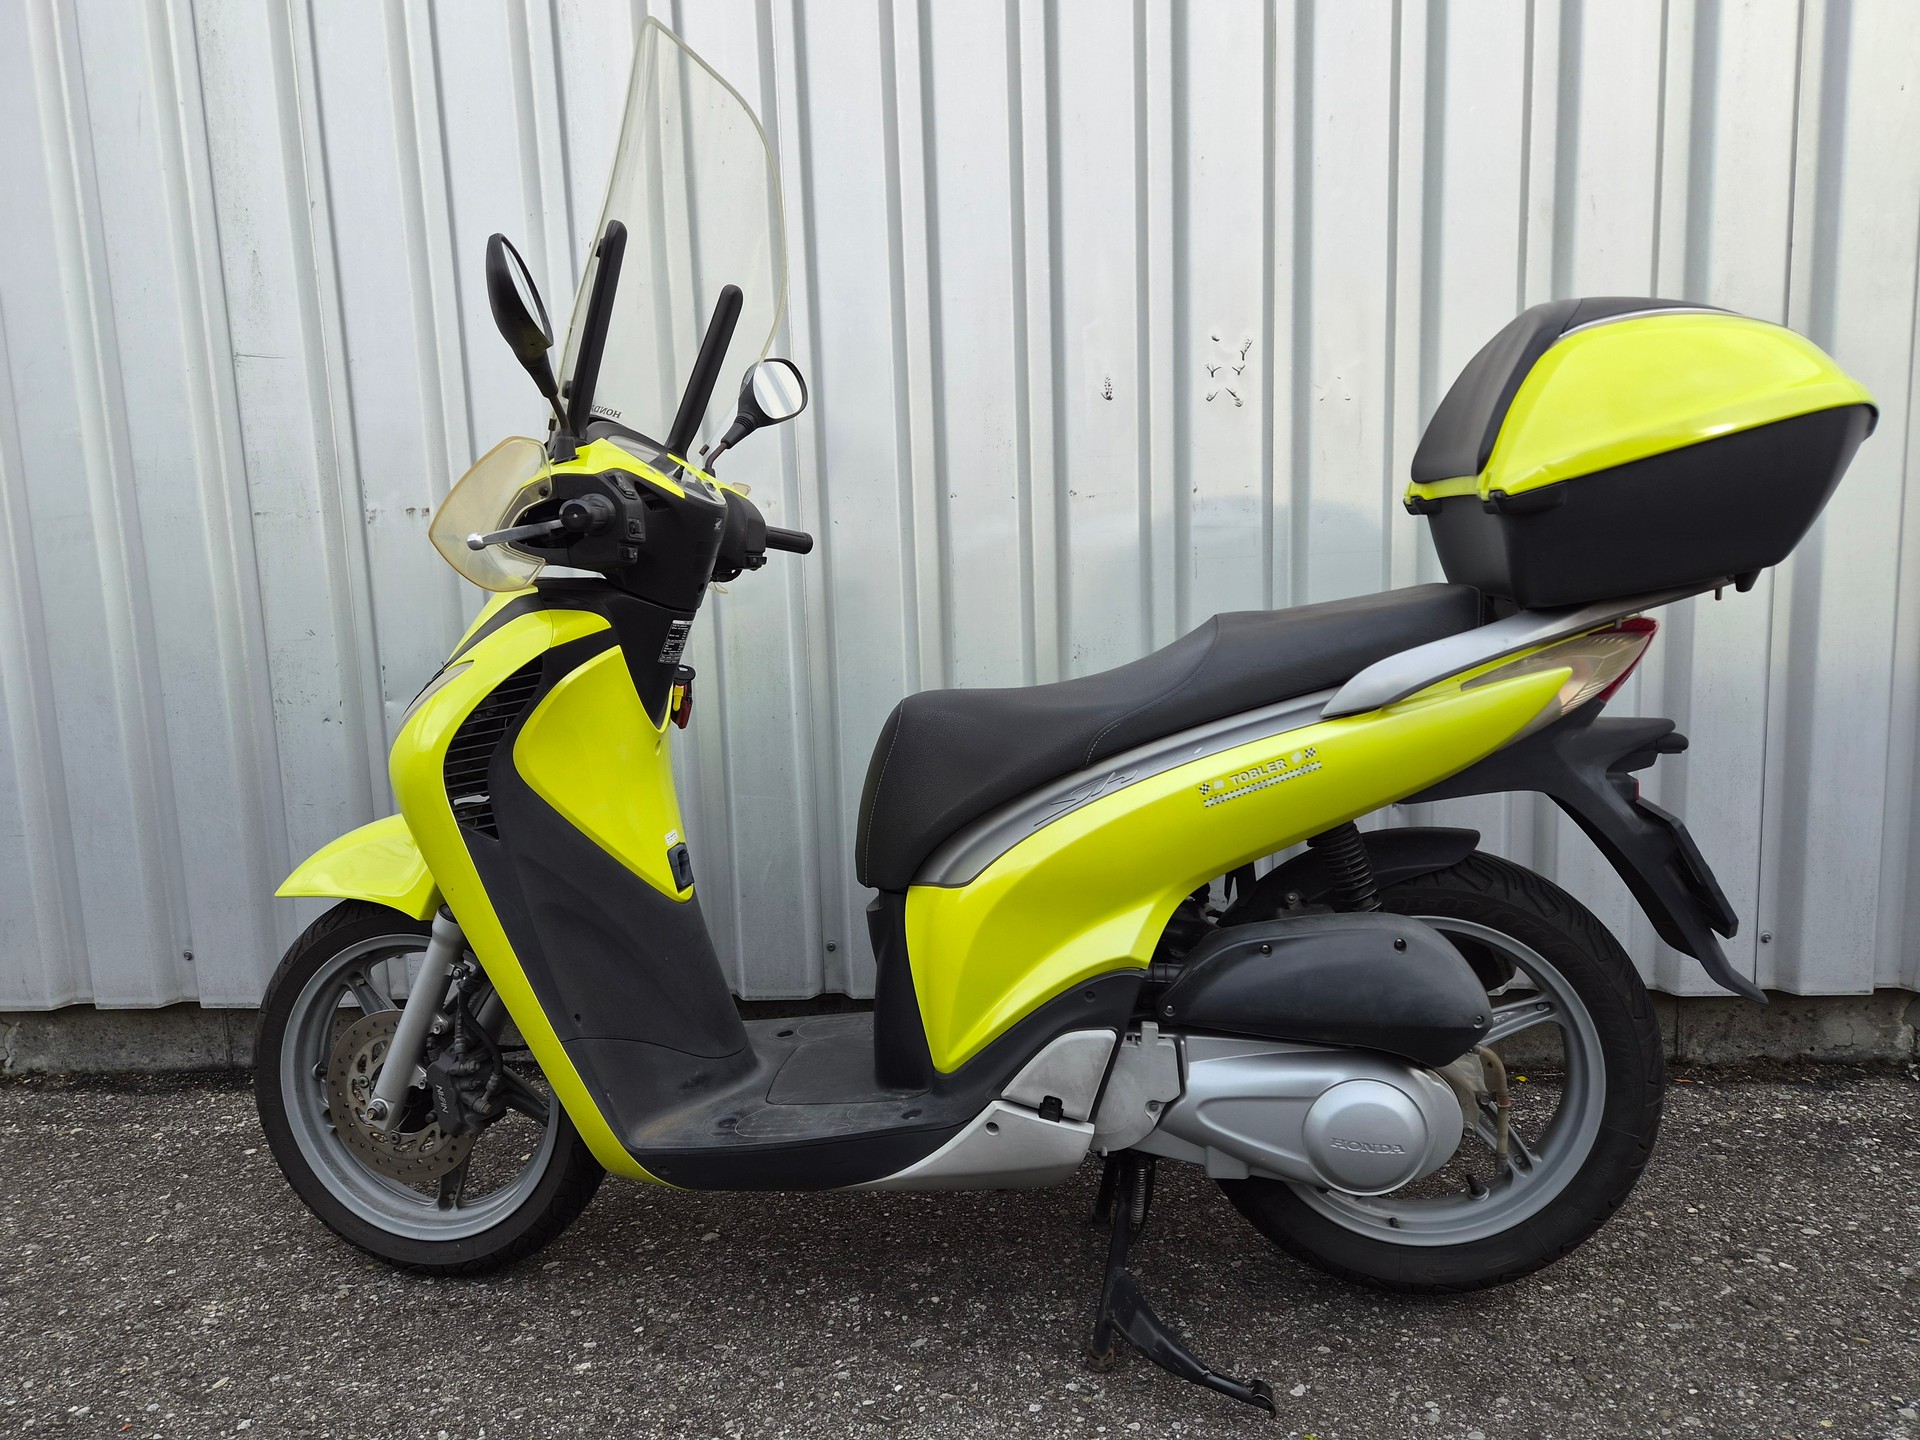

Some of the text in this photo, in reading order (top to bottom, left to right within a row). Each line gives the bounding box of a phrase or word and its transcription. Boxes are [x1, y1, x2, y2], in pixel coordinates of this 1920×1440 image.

[1229, 758, 1287, 786] TOBLER
[435, 1084, 449, 1114] NISSIN
[1330, 1137, 1406, 1155] HONDA
